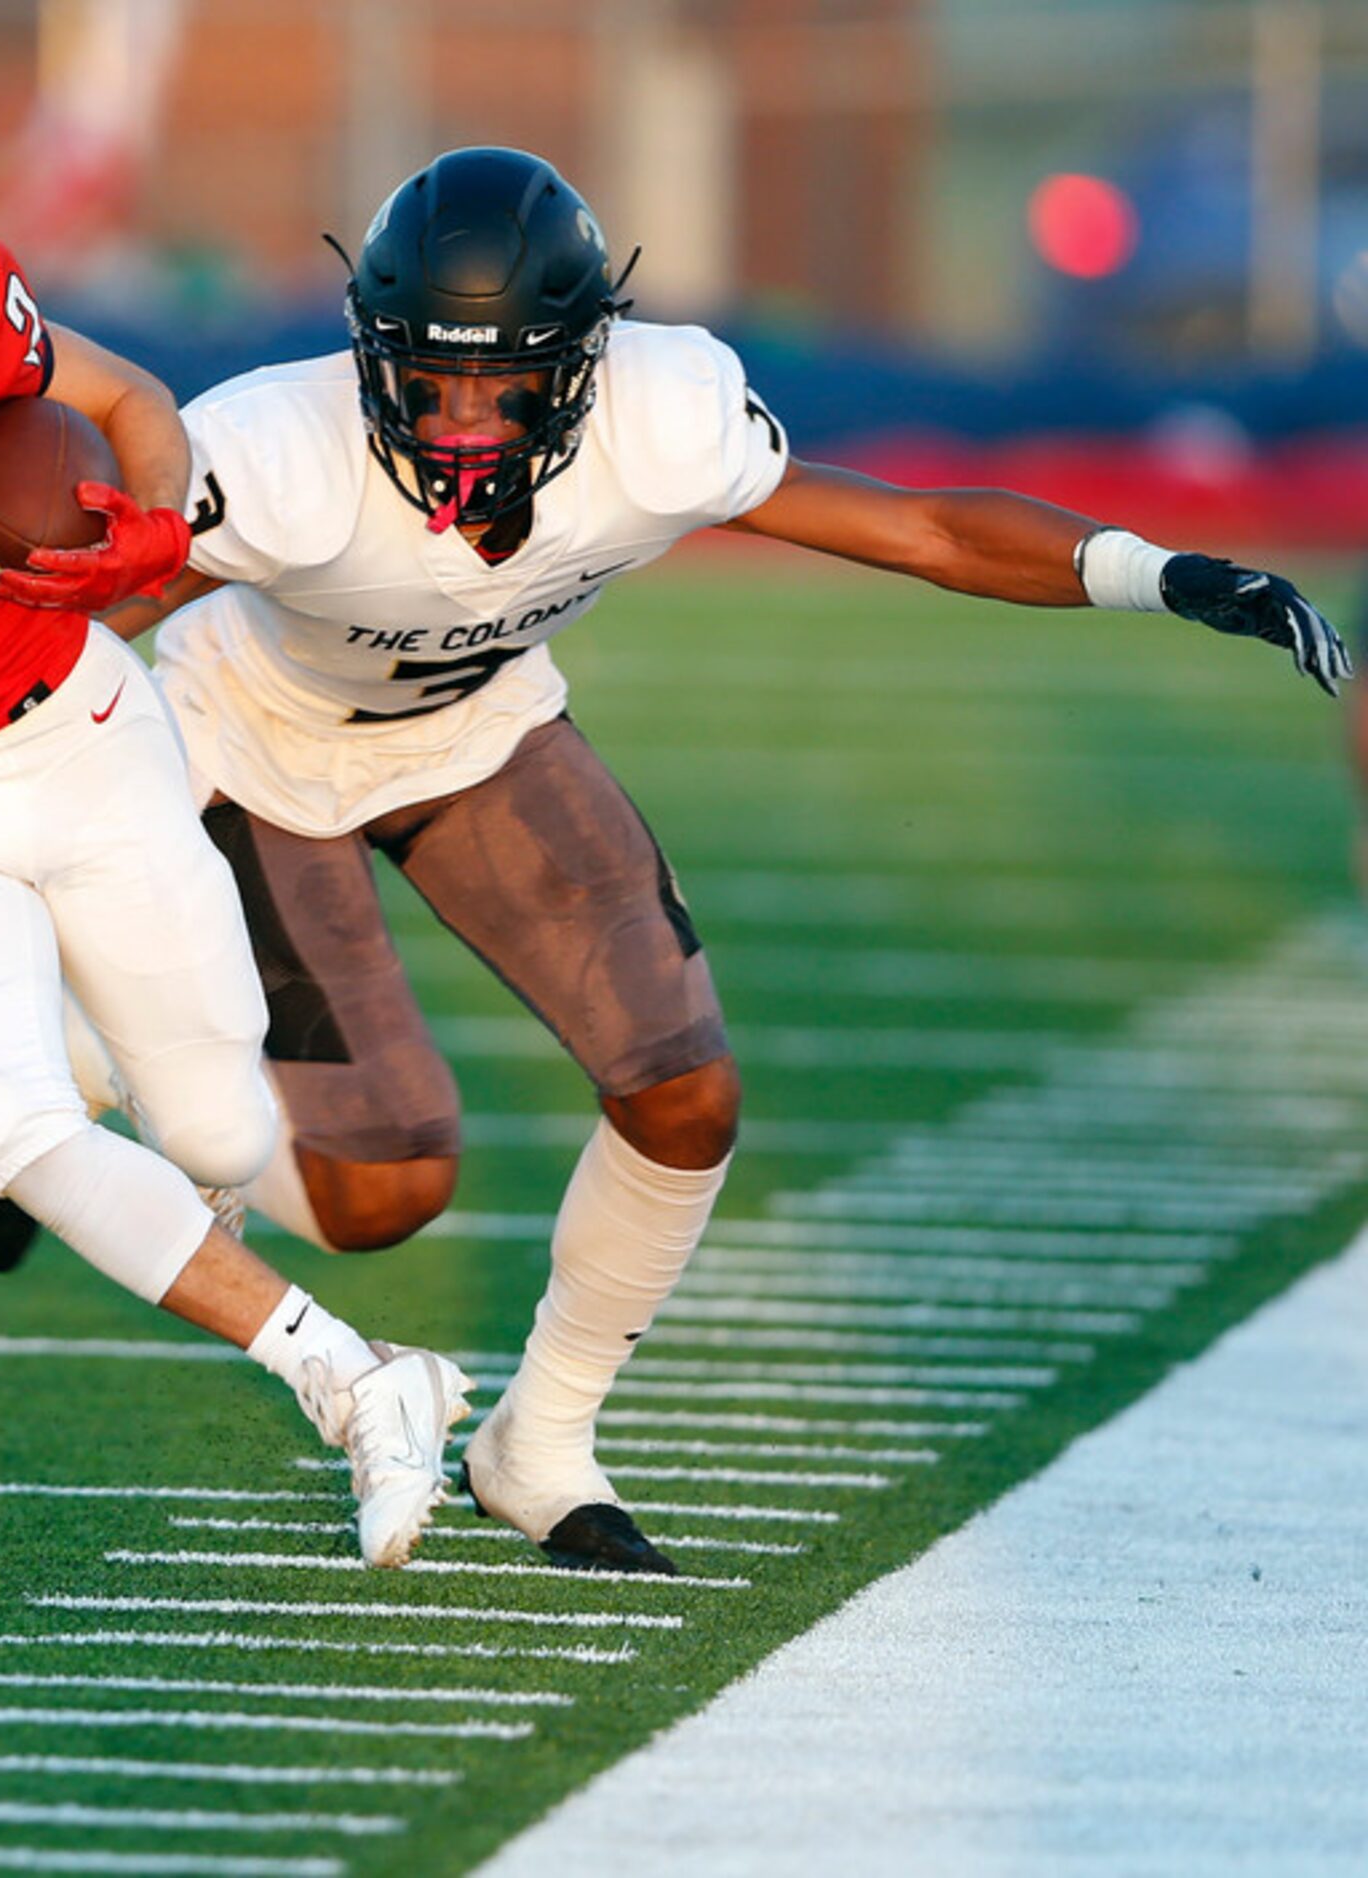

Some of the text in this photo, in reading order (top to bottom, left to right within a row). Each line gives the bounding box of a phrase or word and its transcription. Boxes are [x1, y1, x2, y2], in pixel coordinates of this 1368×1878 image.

[426, 323, 499, 345] Riddell
[345, 626, 430, 652] THE
[342, 646, 532, 724] 3
